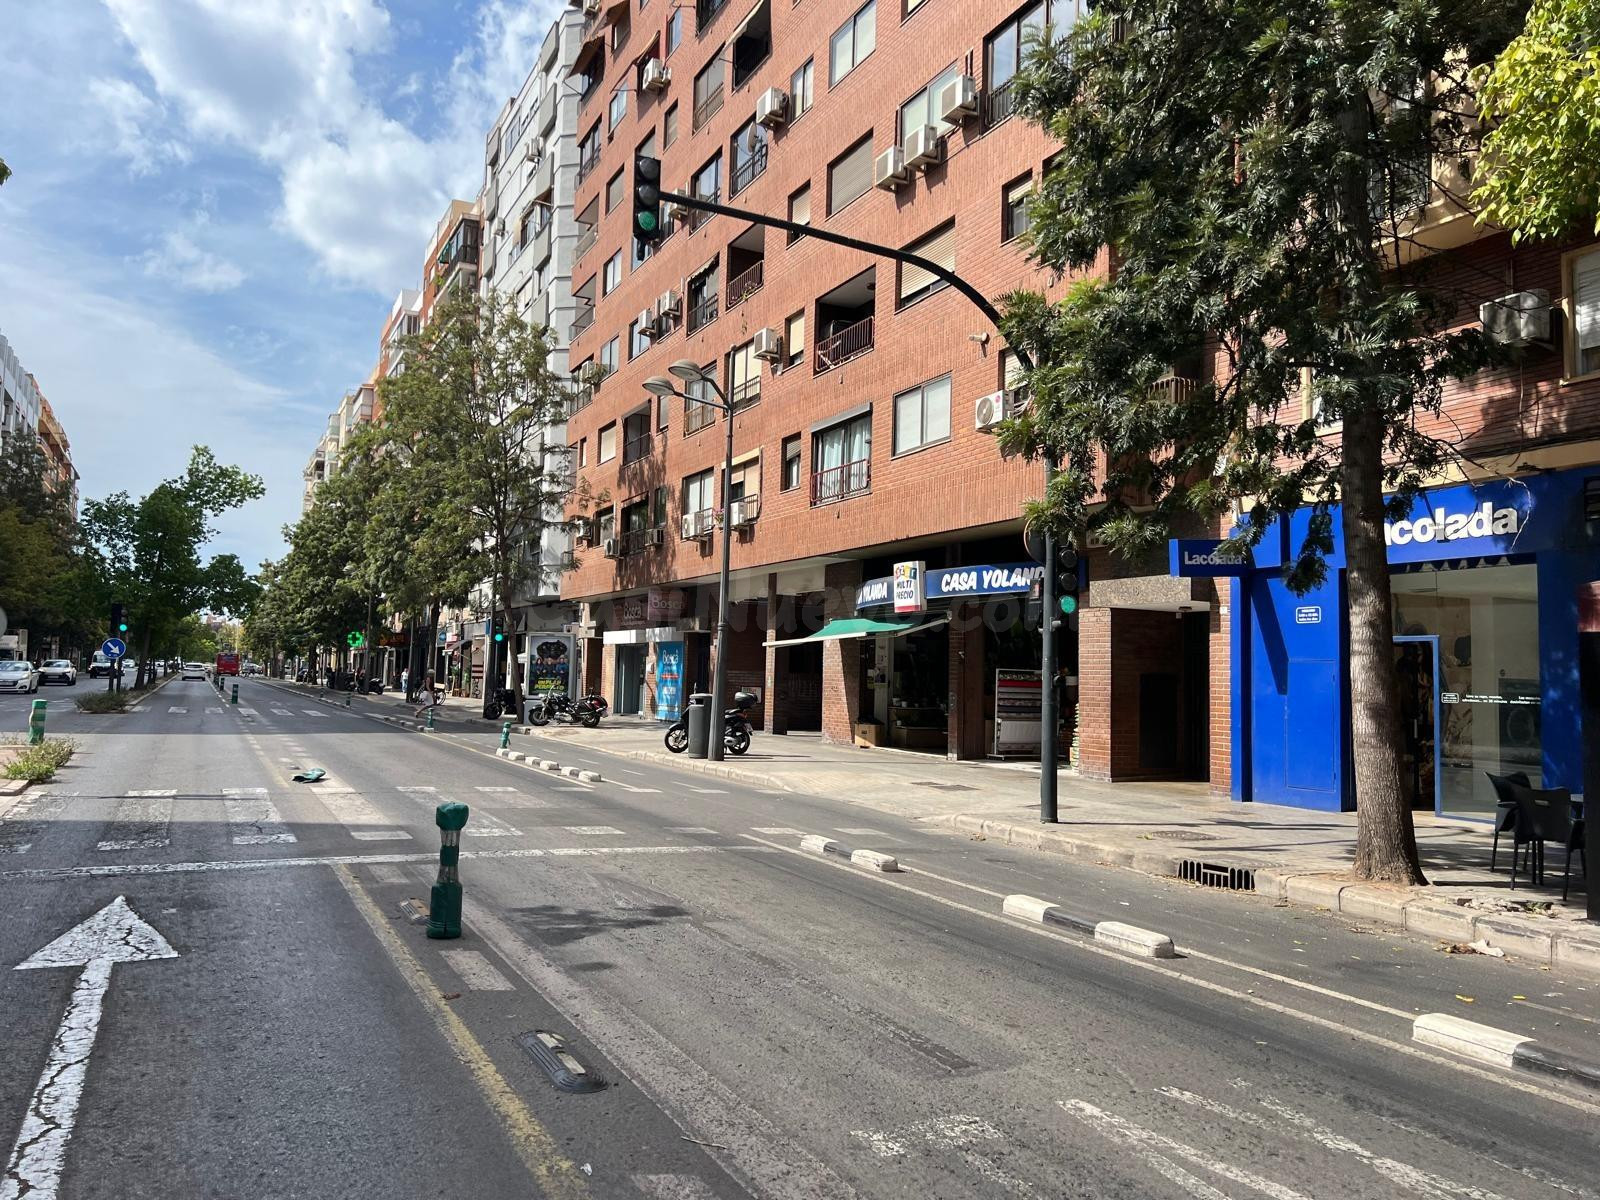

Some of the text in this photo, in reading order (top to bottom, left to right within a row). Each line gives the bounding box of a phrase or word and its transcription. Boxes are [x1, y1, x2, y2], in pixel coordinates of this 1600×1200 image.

[1384, 502, 1518, 545] colada
[1184, 551, 1243, 565] Lacoada
[897, 580, 912, 589] MULTI
[941, 571, 978, 592] CASA
[863, 582, 888, 602] YOLANDA
[896, 590, 914, 600] PRECIO
